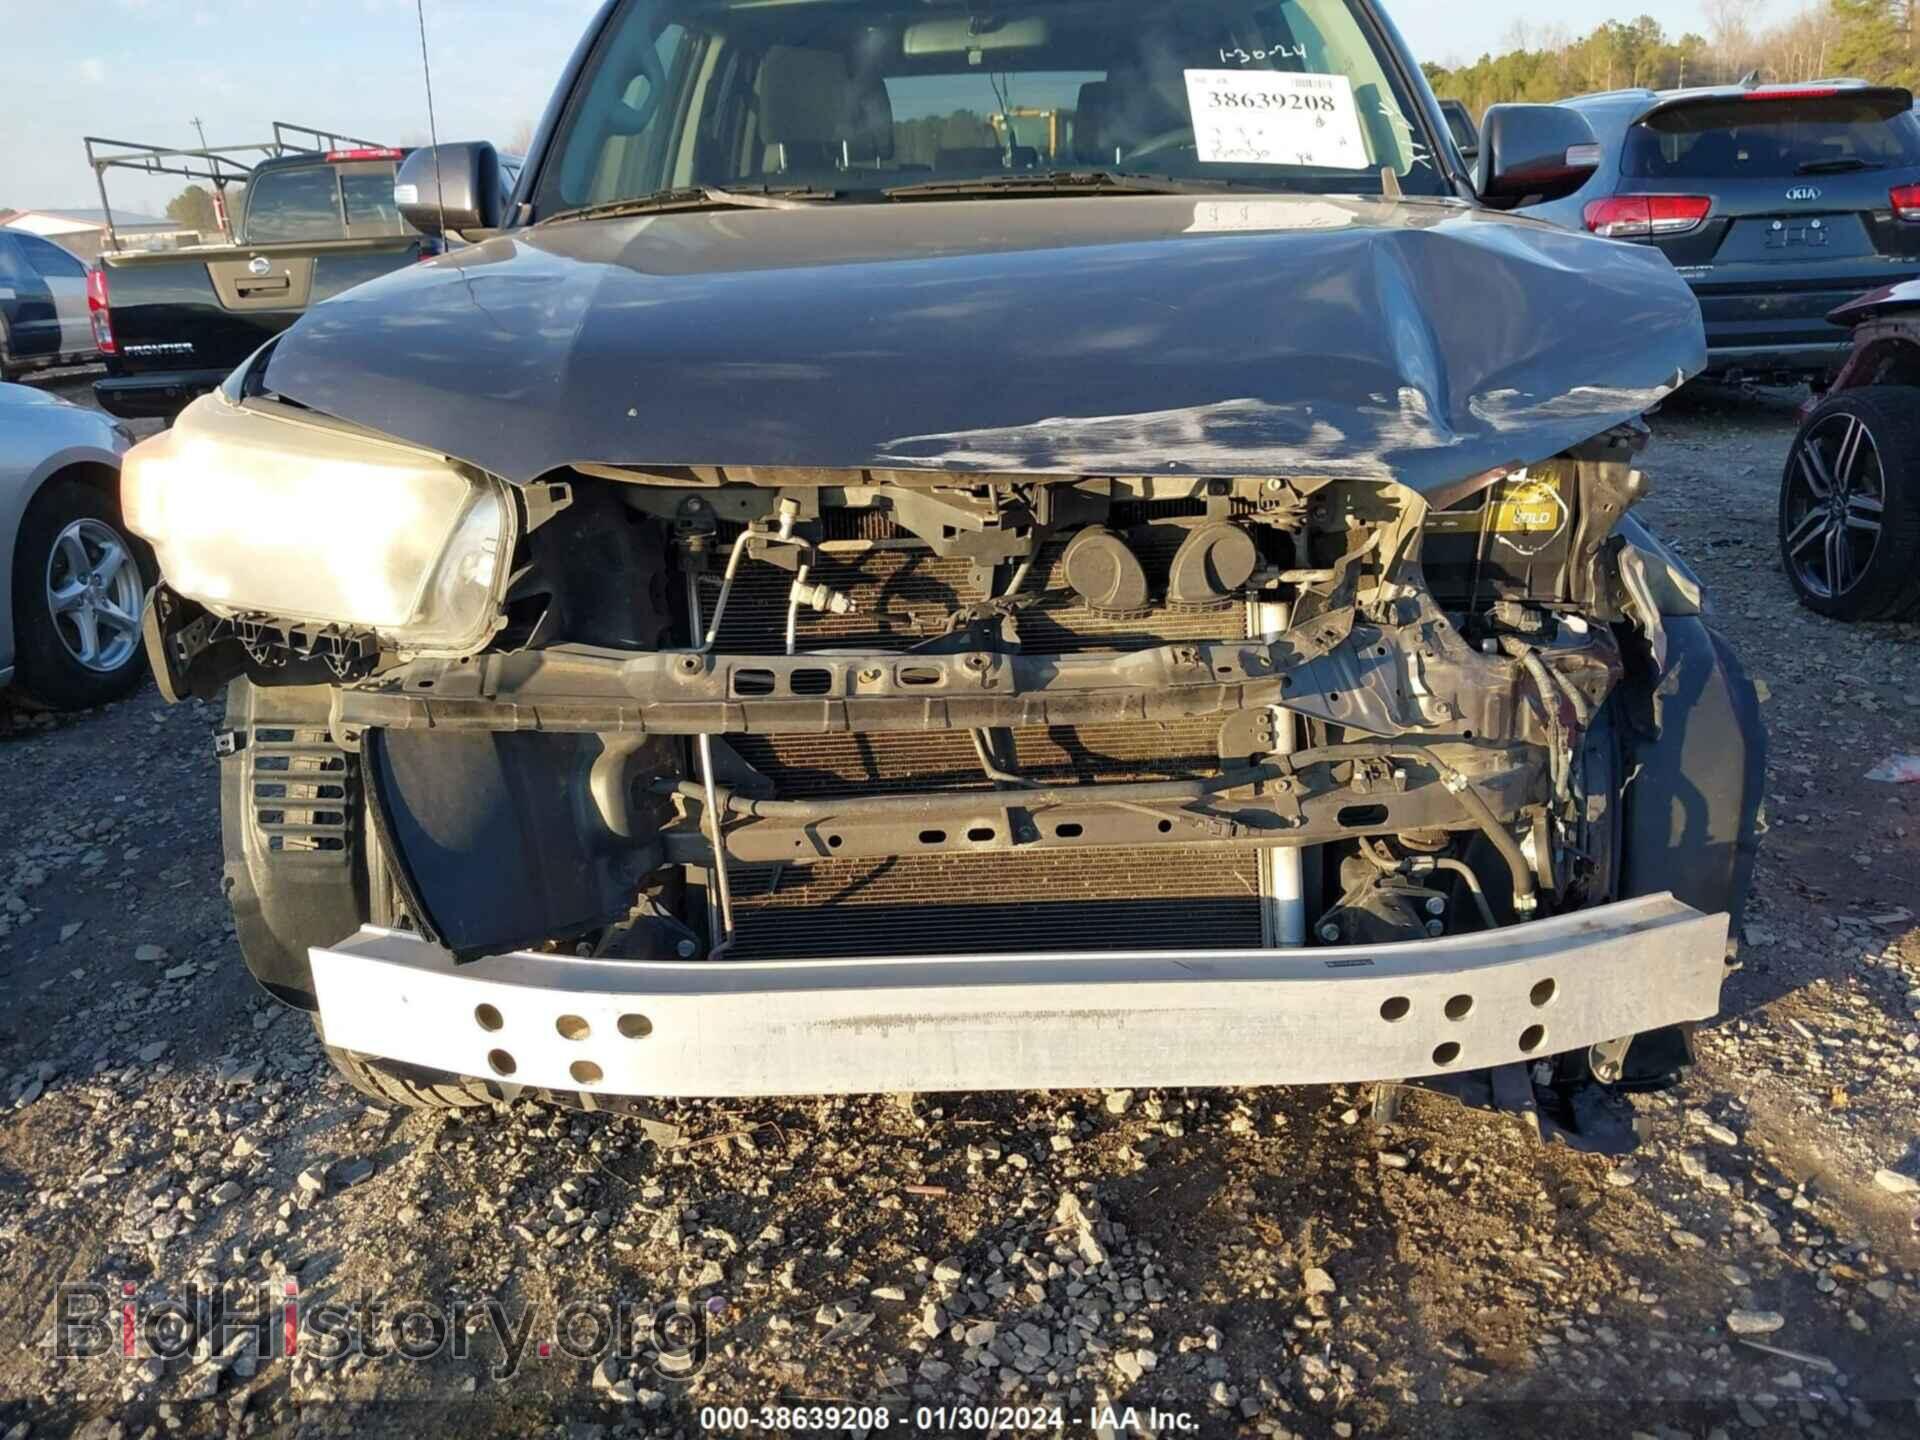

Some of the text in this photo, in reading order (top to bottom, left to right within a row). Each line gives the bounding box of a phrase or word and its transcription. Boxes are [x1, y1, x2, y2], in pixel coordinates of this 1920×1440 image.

[1220, 43, 1307, 64] 1-30-24
[1207, 90, 1336, 112] 38639208
[124, 342, 194, 357] FRONTIER
